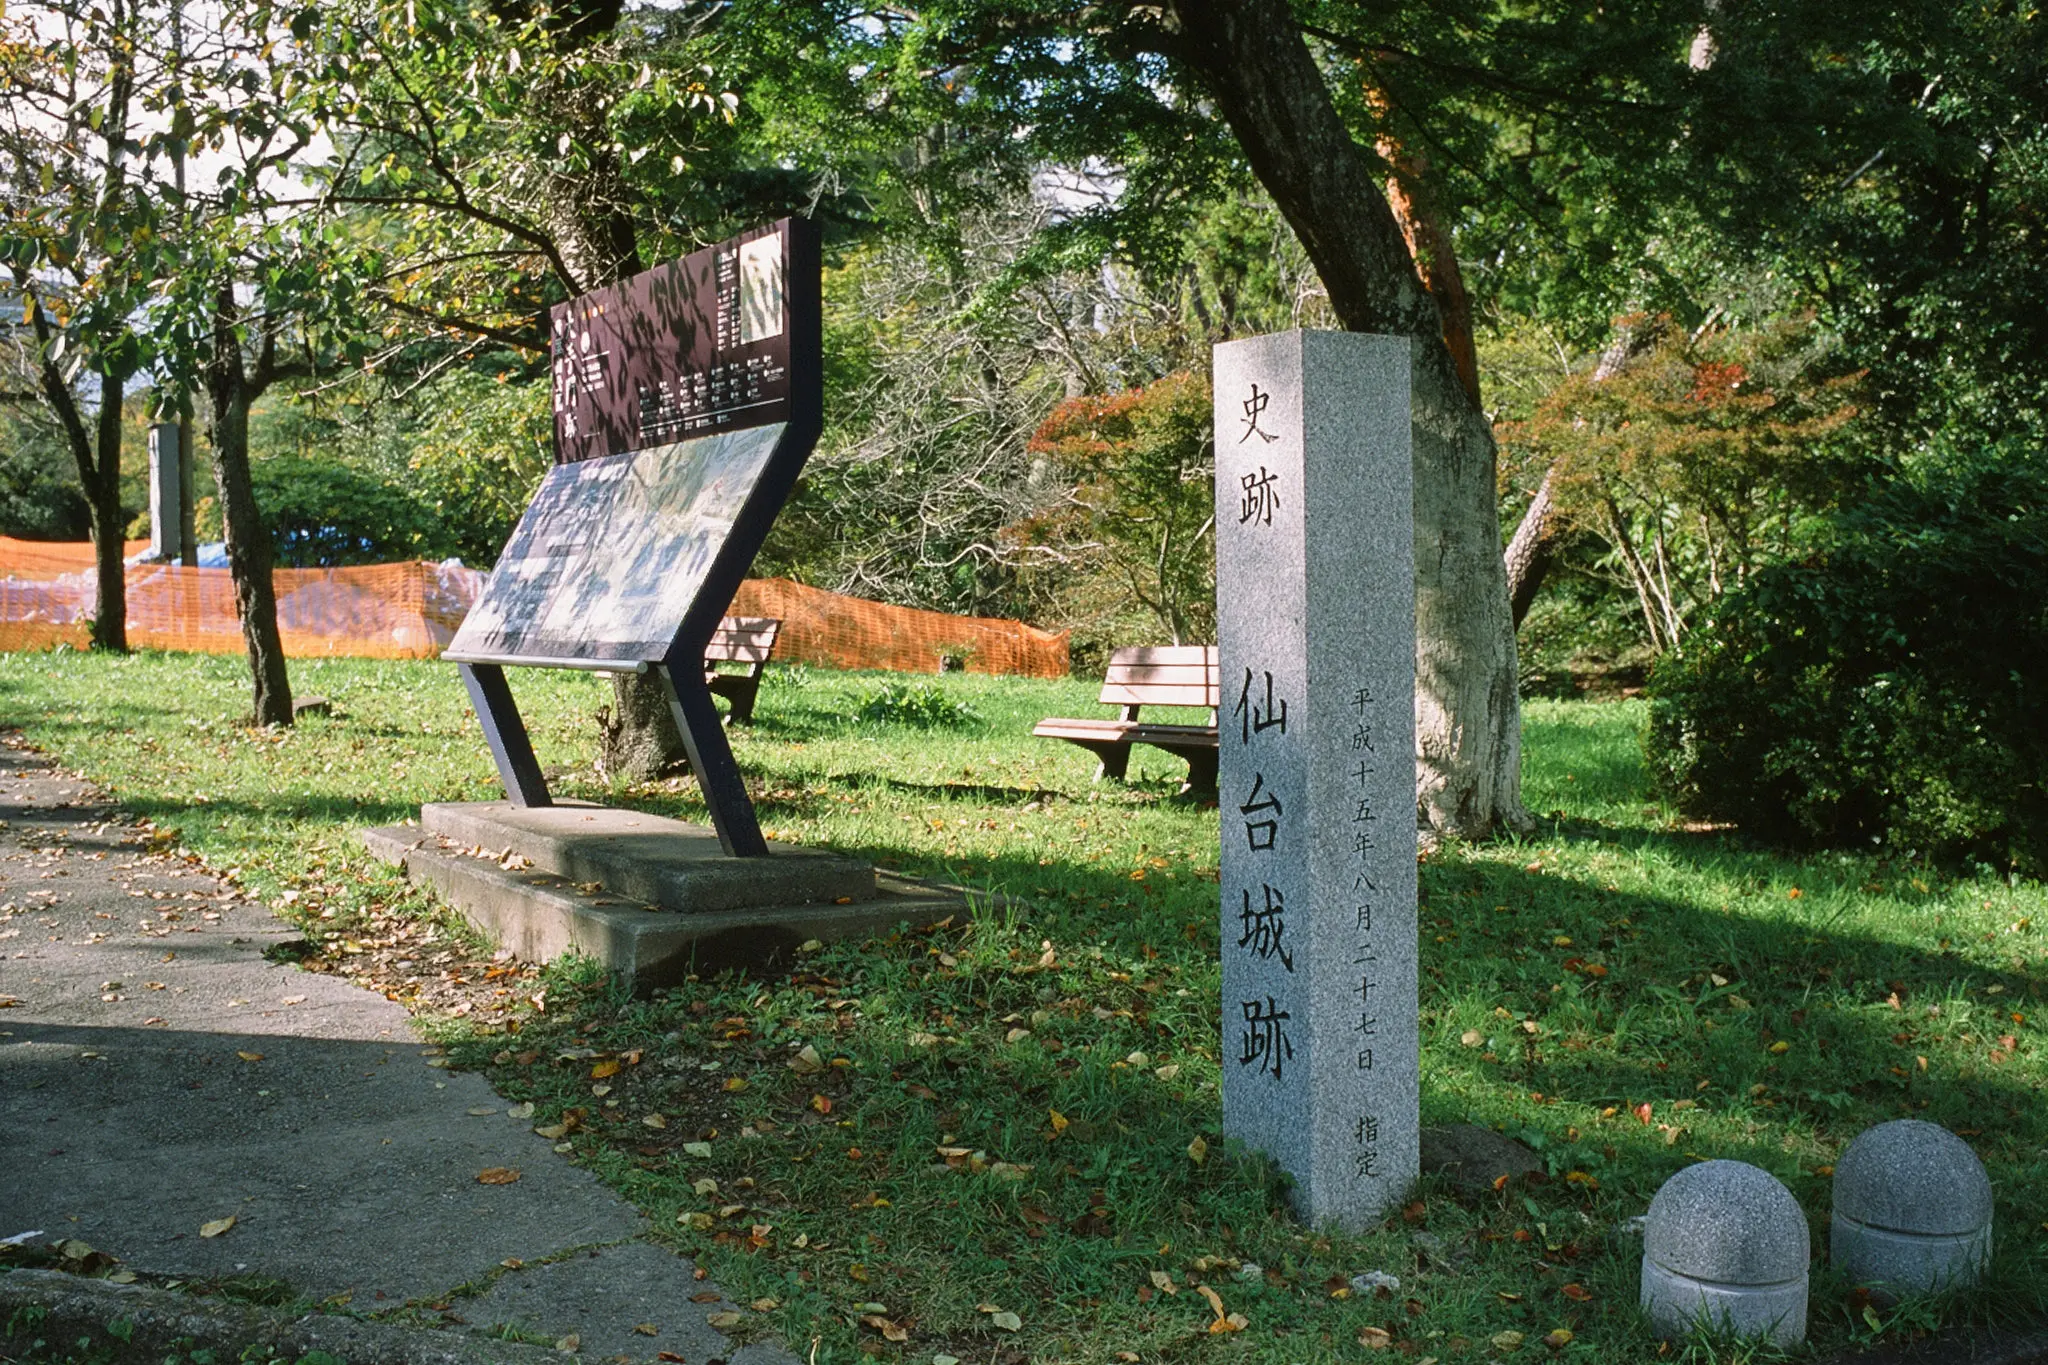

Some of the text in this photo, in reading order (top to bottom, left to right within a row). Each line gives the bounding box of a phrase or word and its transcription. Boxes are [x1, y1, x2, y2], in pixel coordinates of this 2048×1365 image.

[1234, 384, 1293, 1081] 史跡 仙台城跡
[1351, 688, 1378, 1179] 平成十五年八月二十七日 指定
